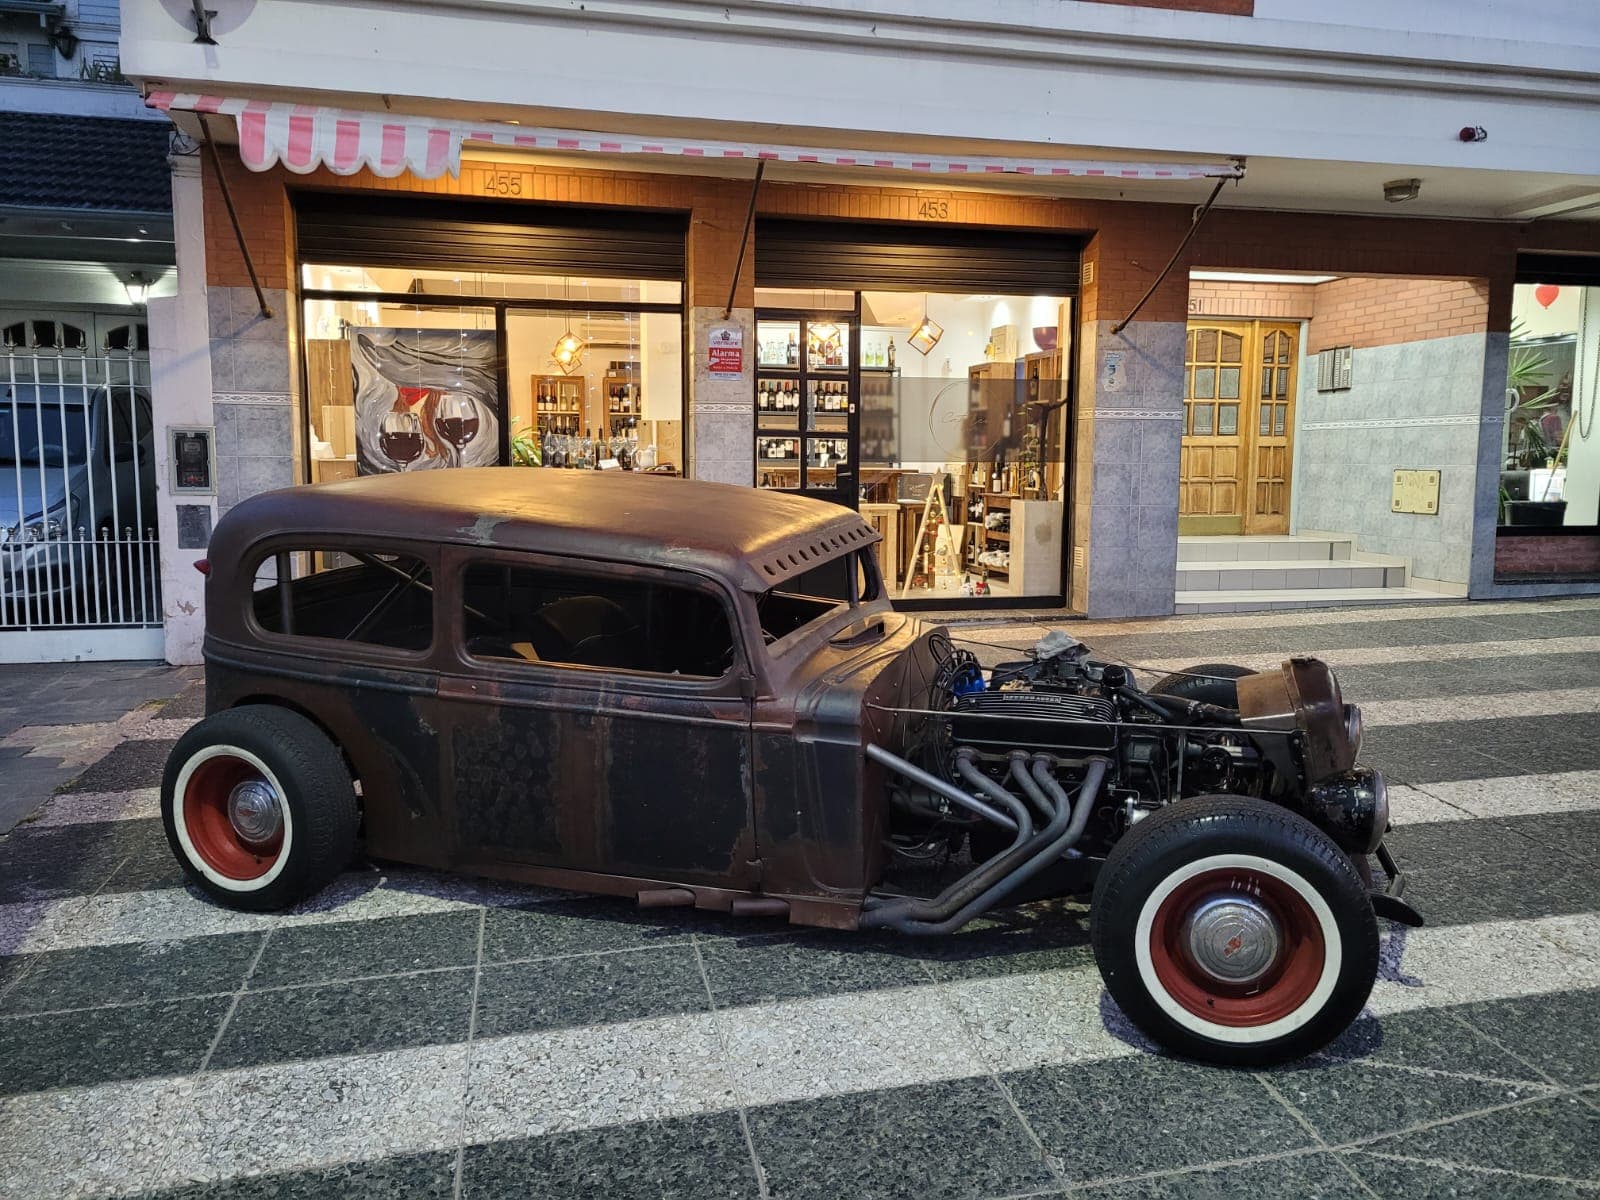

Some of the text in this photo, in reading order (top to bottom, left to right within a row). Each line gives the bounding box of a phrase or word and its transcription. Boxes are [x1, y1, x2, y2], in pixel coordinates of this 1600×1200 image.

[484, 175, 522, 196] 455
[919, 201, 948, 219] 453
[711, 348, 740, 358] Alarma
